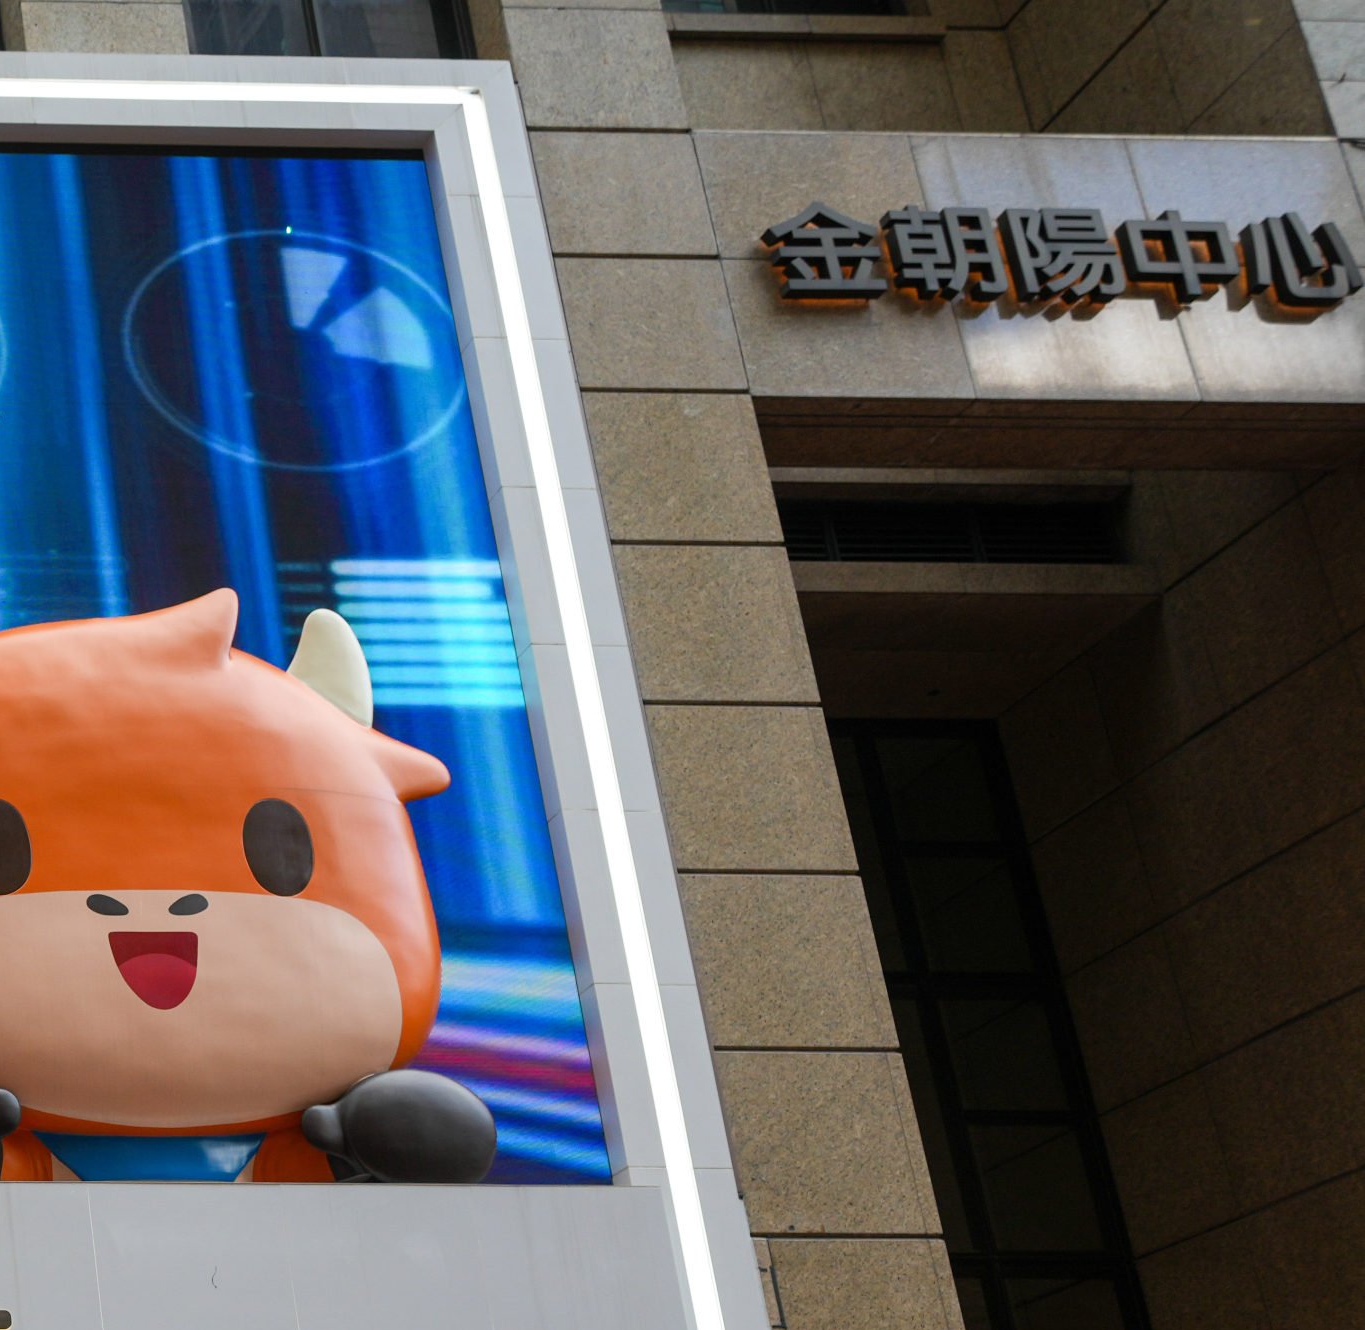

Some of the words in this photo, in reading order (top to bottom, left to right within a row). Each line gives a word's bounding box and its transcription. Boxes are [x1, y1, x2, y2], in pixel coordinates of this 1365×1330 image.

[760, 201, 1364, 304] 金朝陽中心
